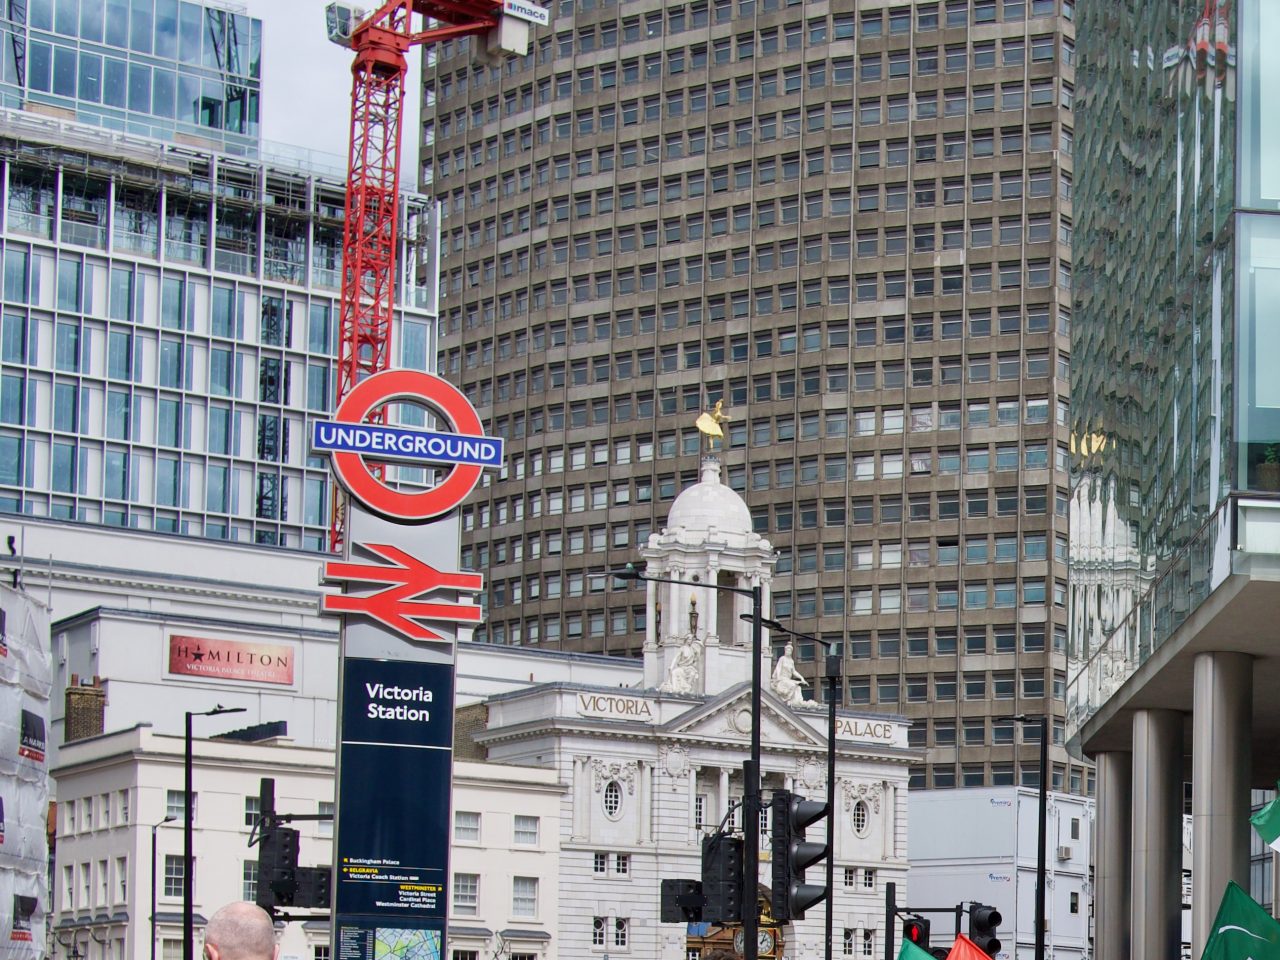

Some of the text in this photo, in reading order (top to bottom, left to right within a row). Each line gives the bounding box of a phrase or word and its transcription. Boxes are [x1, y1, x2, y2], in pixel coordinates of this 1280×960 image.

[516, 5, 546, 20] mace
[320, 427, 495, 461] UNDERGROUND
[186, 663, 220, 673] VICTORIA
[366, 683, 433, 702] Victoria
[367, 703, 430, 722] Station
[579, 694, 652, 717] VICTORIA
[835, 720, 892, 739] PALACE
